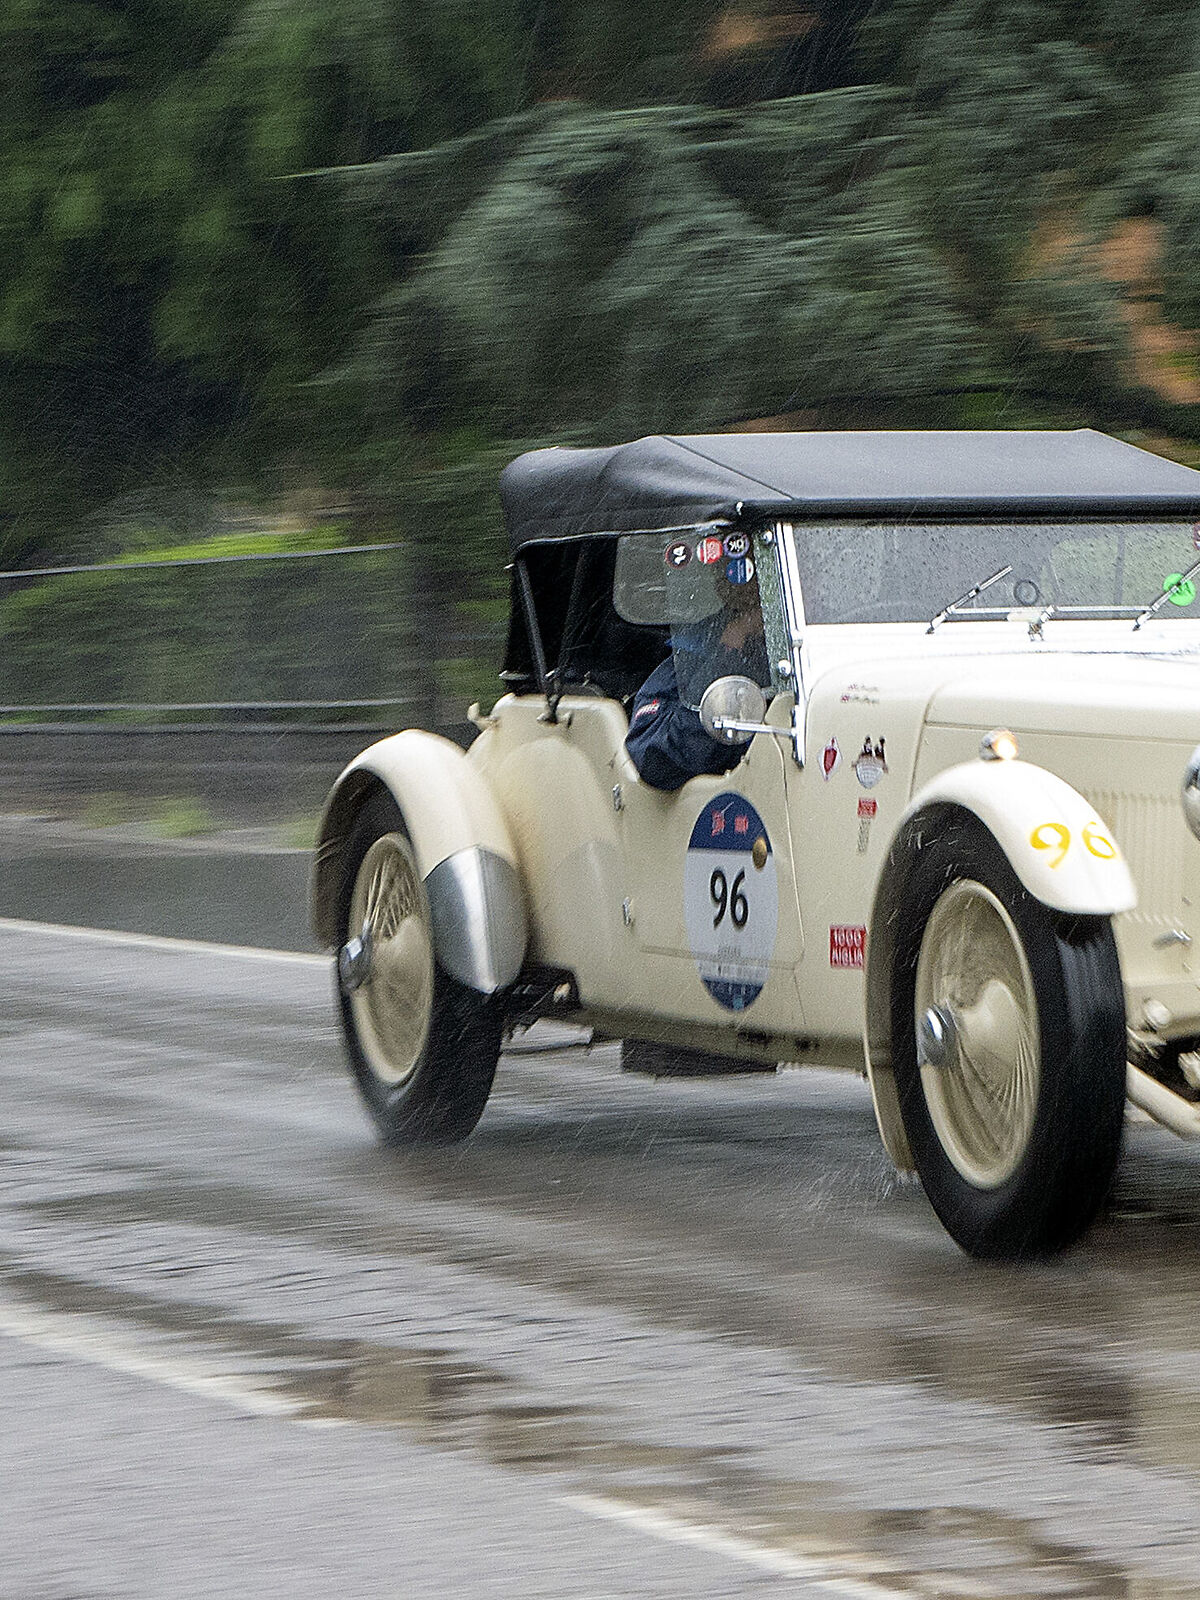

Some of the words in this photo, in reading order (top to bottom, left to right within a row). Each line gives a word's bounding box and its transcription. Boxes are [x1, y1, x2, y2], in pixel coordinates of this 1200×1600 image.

[1030, 821, 1117, 869] 96
[710, 867, 749, 929] 96
[833, 928, 862, 947] 1000
